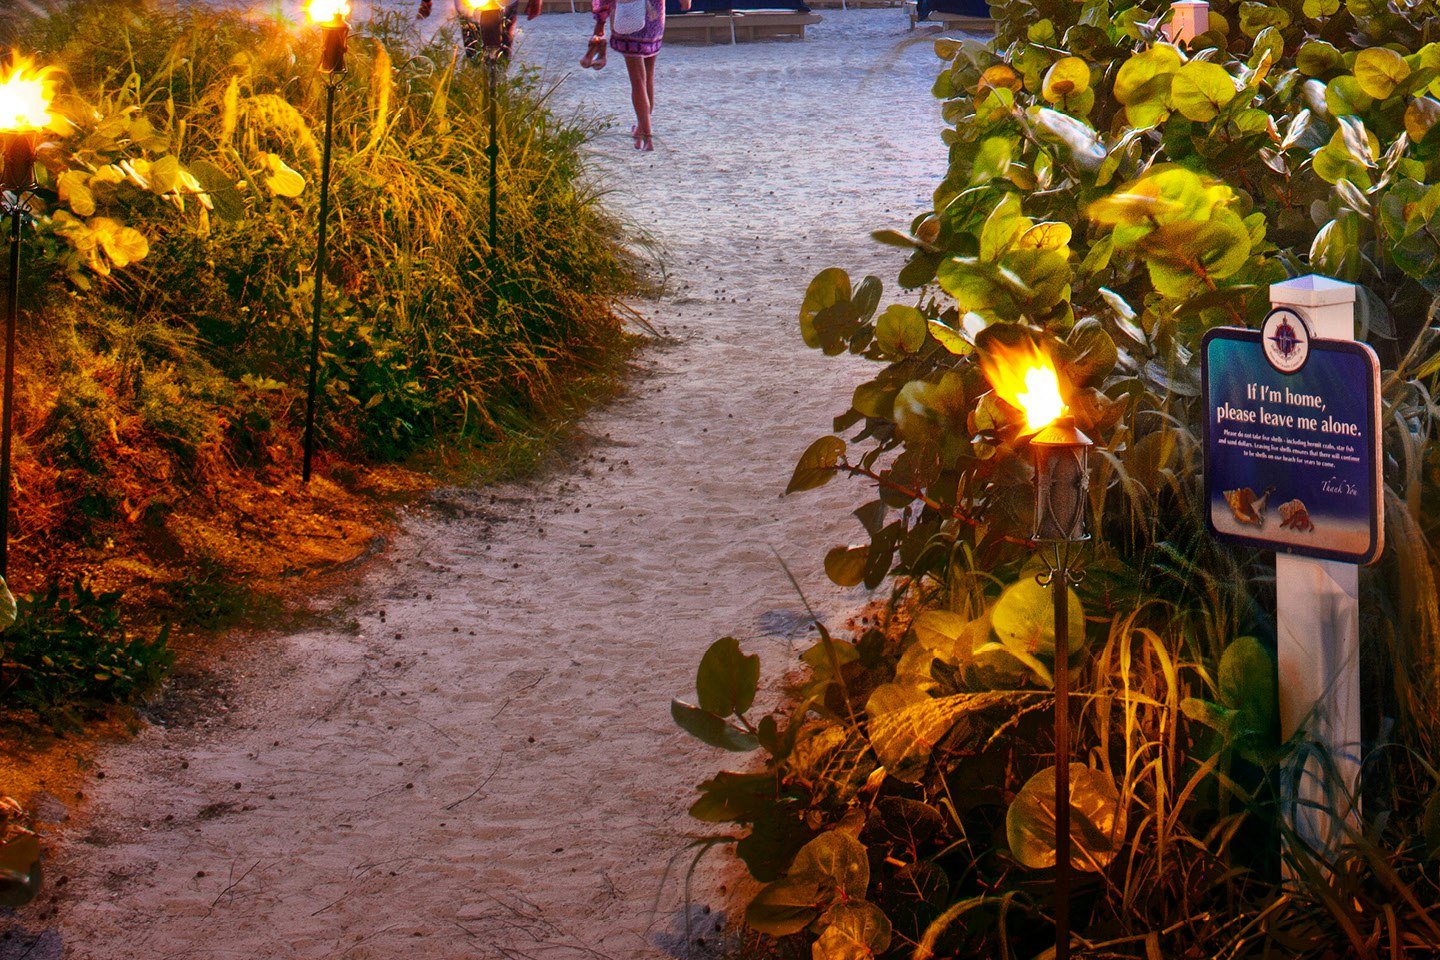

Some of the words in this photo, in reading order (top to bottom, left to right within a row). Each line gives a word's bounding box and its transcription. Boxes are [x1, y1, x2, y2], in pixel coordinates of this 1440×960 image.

[1247, 383, 1257, 400] If
[1260, 385, 1282, 403] I'm
[1285, 387, 1326, 412] home,
[1216, 402, 1256, 423] please
[1259, 407, 1293, 428] leave
[1297, 416, 1318, 431] me
[1321, 415, 1362, 437] alone.
[1286, 437, 1306, 447] including
[1307, 440, 1321, 449] hermit
[1341, 454, 1360, 462] continue
[1321, 476, 1342, 493] Thank
[1346, 484, 1357, 496] You
